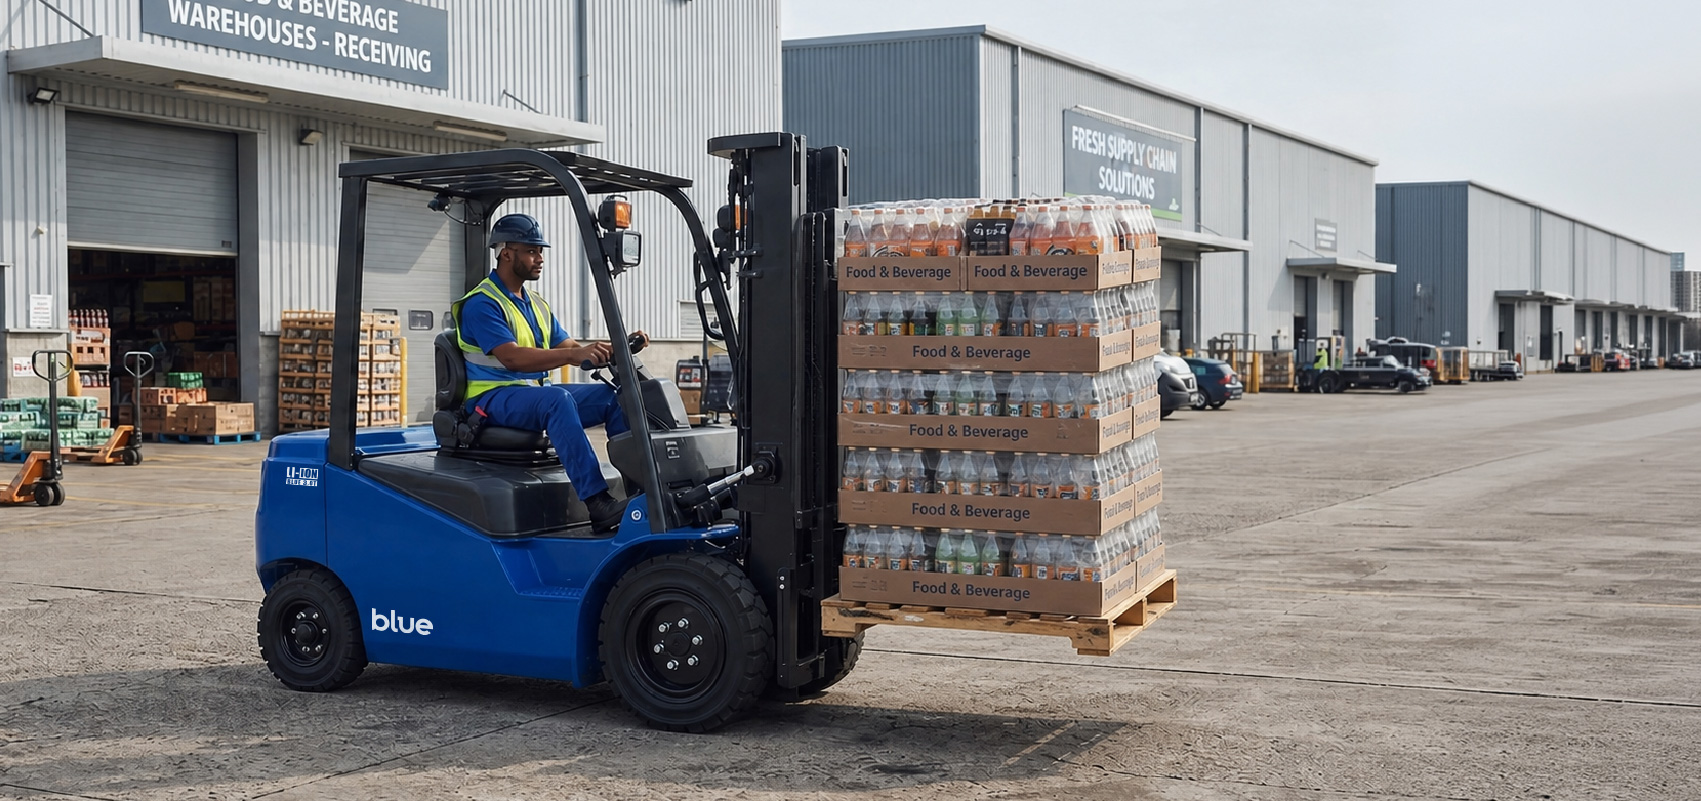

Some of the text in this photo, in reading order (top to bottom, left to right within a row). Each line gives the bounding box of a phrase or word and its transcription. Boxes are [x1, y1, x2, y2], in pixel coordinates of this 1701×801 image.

[299, 0, 399, 33] BEVERAGE
[168, 0, 317, 51] WAREHOUSES
[334, 31, 432, 73] RECEIVING
[1071, 125, 1177, 174] FRESH SUPPLY CHAIN
[1098, 165, 1156, 200] SOLUTIONS
[846, 265, 952, 281] Food & Beverage
[974, 264, 1007, 278] Food
[1010, 265, 1021, 278] &
[1023, 264, 1088, 281] Beverage
[912, 345, 1031, 362] Food & Beverage
[909, 423, 1029, 442] Food & Beverage
[286, 466, 319, 480] LI-ION
[912, 502, 1031, 523] Food & Beverage
[912, 580, 1031, 600] Food & Beverage
[371, 607, 434, 636] blue
